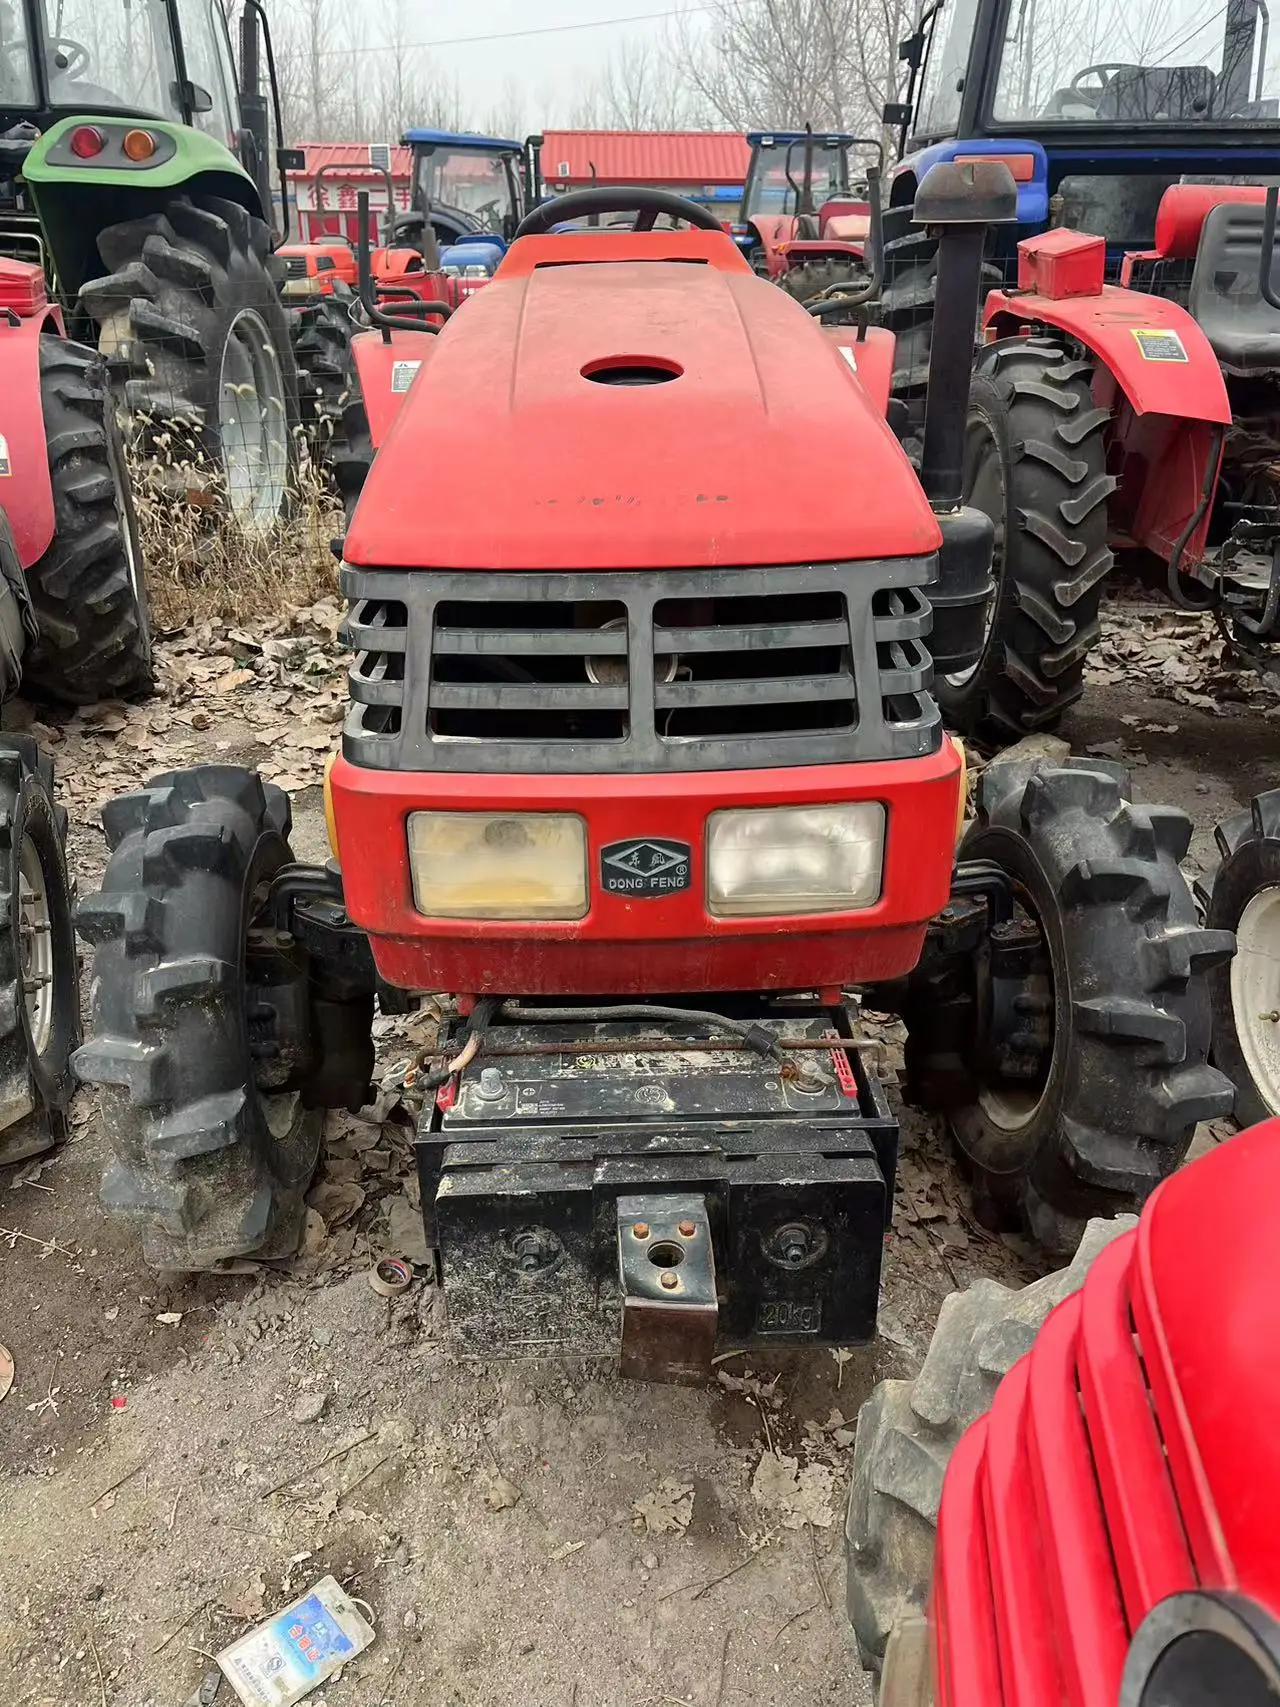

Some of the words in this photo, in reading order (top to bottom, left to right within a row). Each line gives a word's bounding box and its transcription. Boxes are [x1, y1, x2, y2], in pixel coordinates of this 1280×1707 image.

[609, 878, 643, 890] DONG
[650, 877, 685, 888] FENG
[760, 1301, 813, 1329] 20kg
